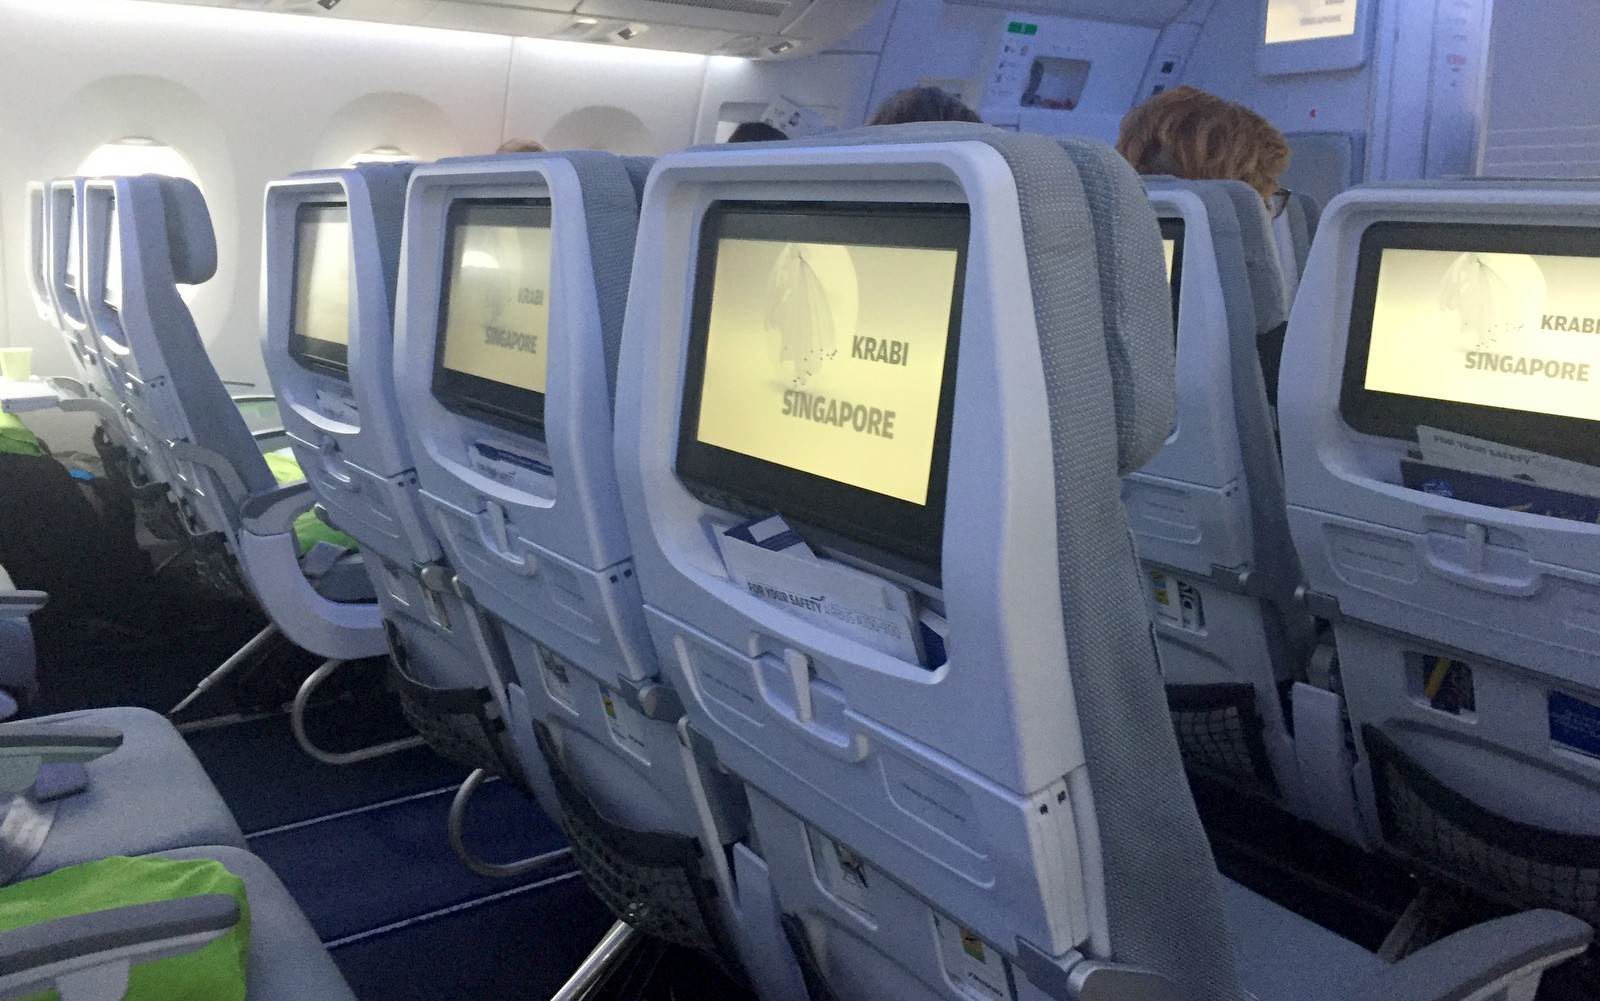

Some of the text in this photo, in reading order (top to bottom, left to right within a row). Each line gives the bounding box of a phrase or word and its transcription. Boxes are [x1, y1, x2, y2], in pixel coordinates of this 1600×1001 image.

[484, 326, 538, 354] SINGAPORE
[851, 335, 909, 366] KRABI
[1464, 351, 1590, 382] SINGAPORE
[782, 389, 896, 439] SINGAPORE
[748, 582, 764, 598] FOR
[765, 586, 789, 603] YOUR
[788, 594, 822, 613] SAFETY
